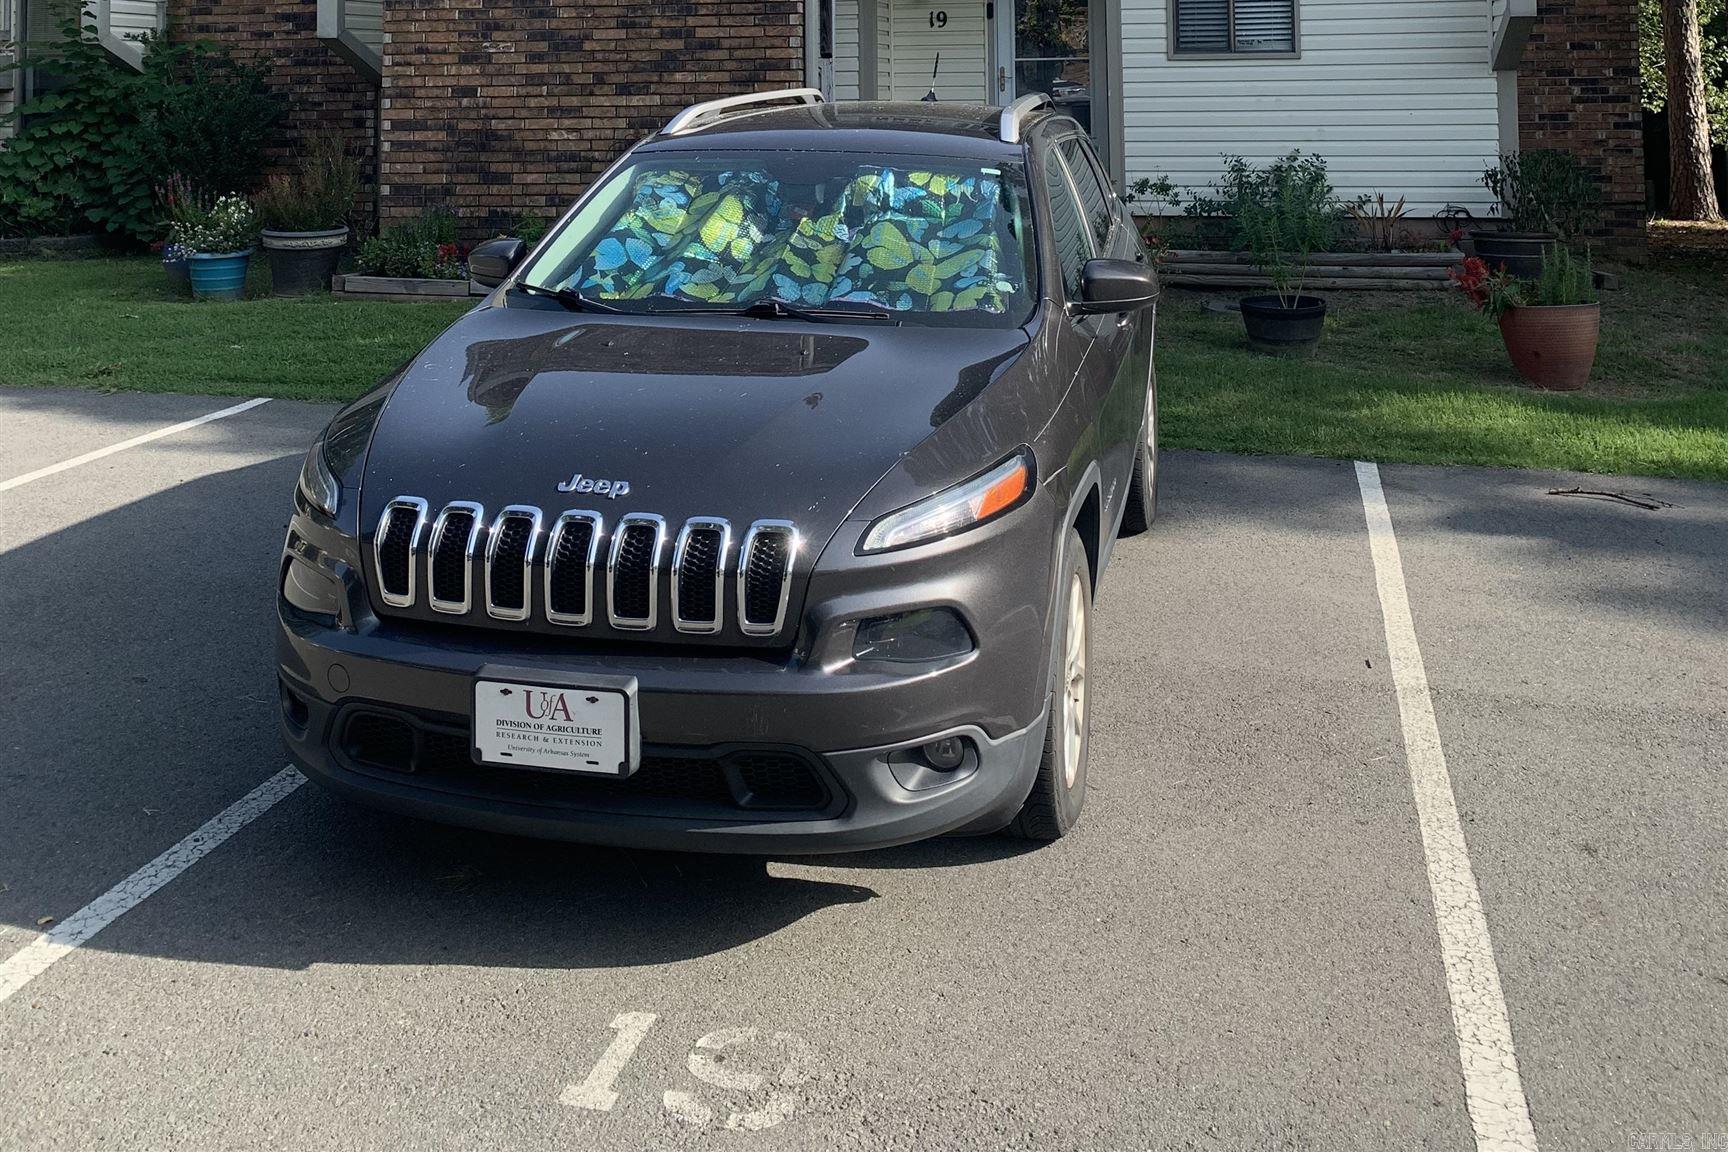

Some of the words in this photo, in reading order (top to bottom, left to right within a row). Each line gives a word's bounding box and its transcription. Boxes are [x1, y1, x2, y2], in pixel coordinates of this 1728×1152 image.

[929, 10, 948, 29] 19
[557, 473, 630, 500] Jeep
[496, 719, 532, 730] DIVISION
[534, 723, 545, 731] OF
[546, 725, 603, 736] AGRICULTURE
[496, 731, 539, 742] RESEARCH
[553, 737, 602, 747] EXTENSION
[507, 744, 535, 754] University
[536, 747, 543, 755] of
[543, 748, 569, 757] Arkansas
[570, 751, 590, 759] System
